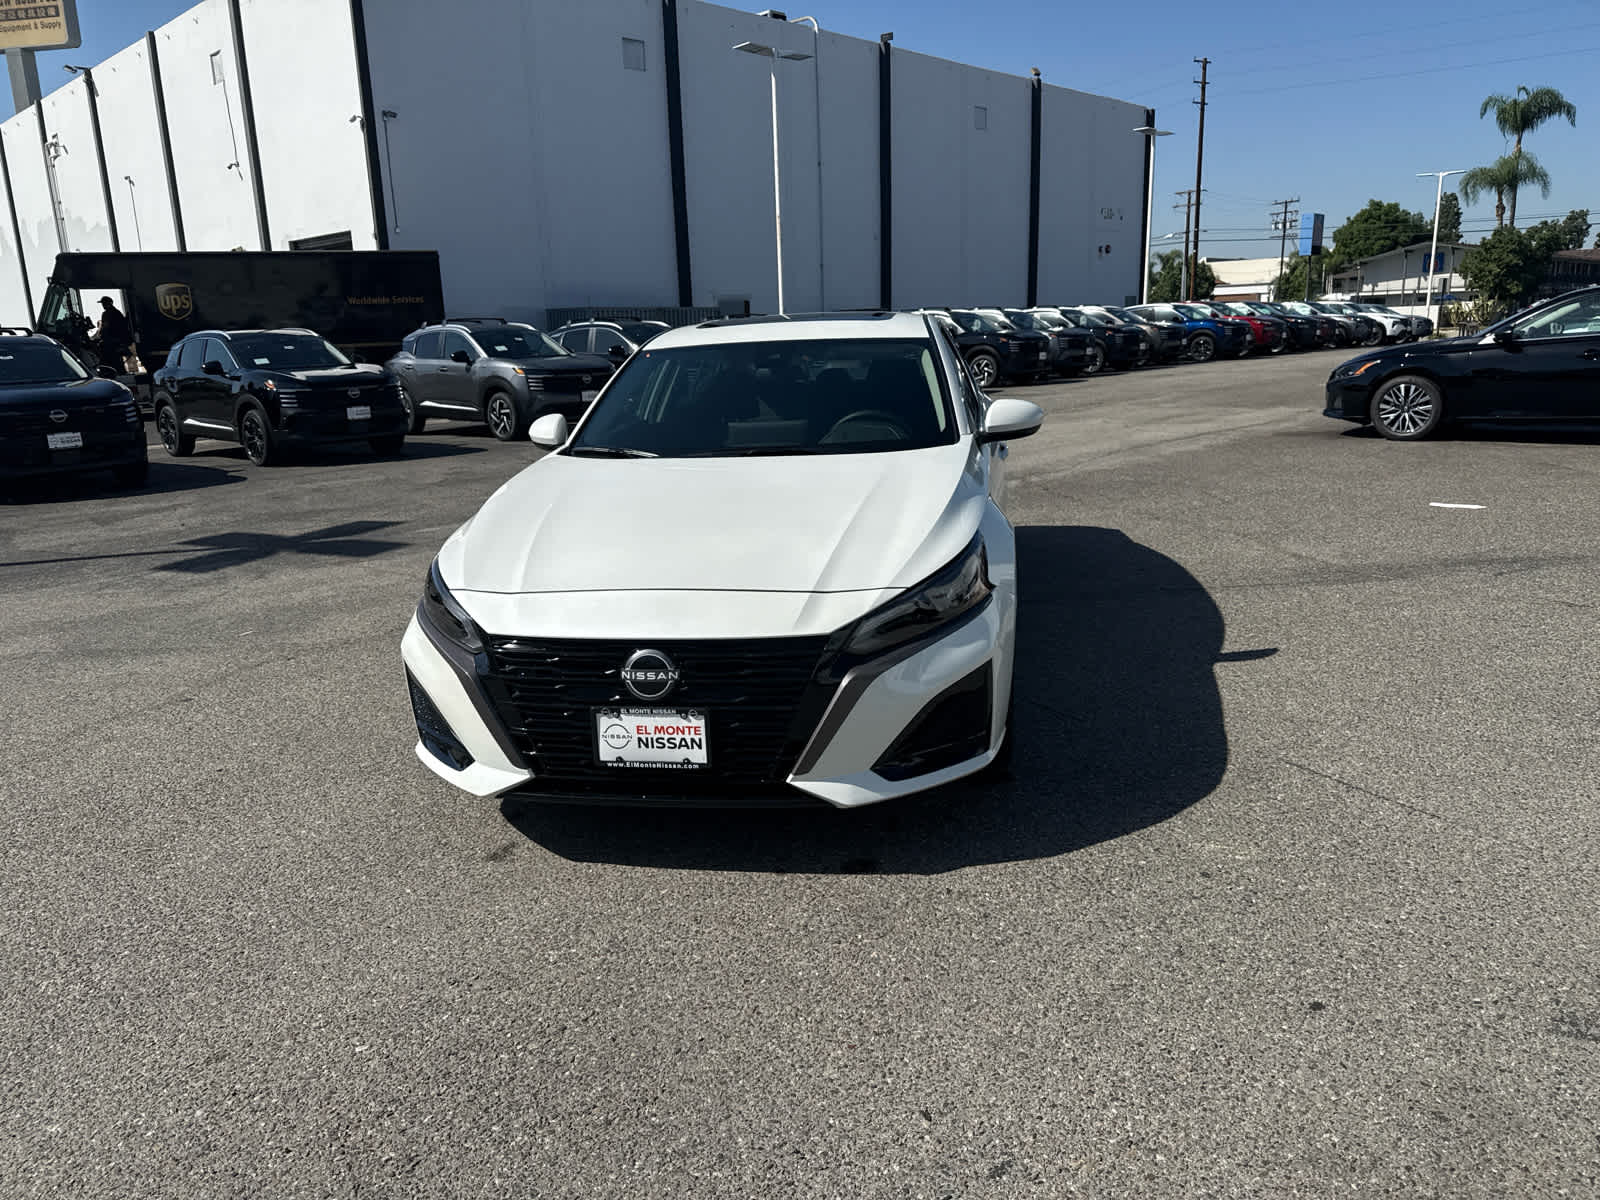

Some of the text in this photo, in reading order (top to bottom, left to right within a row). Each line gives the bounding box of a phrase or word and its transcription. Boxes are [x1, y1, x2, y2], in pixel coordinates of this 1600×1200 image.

[40, 20, 61, 30] Supply
[160, 295, 190, 315] ups
[346, 296, 390, 304] Worldwide
[622, 672, 678, 680] NISSAN
[636, 725, 702, 736] EL MONTE
[638, 737, 702, 750] NISSAN
